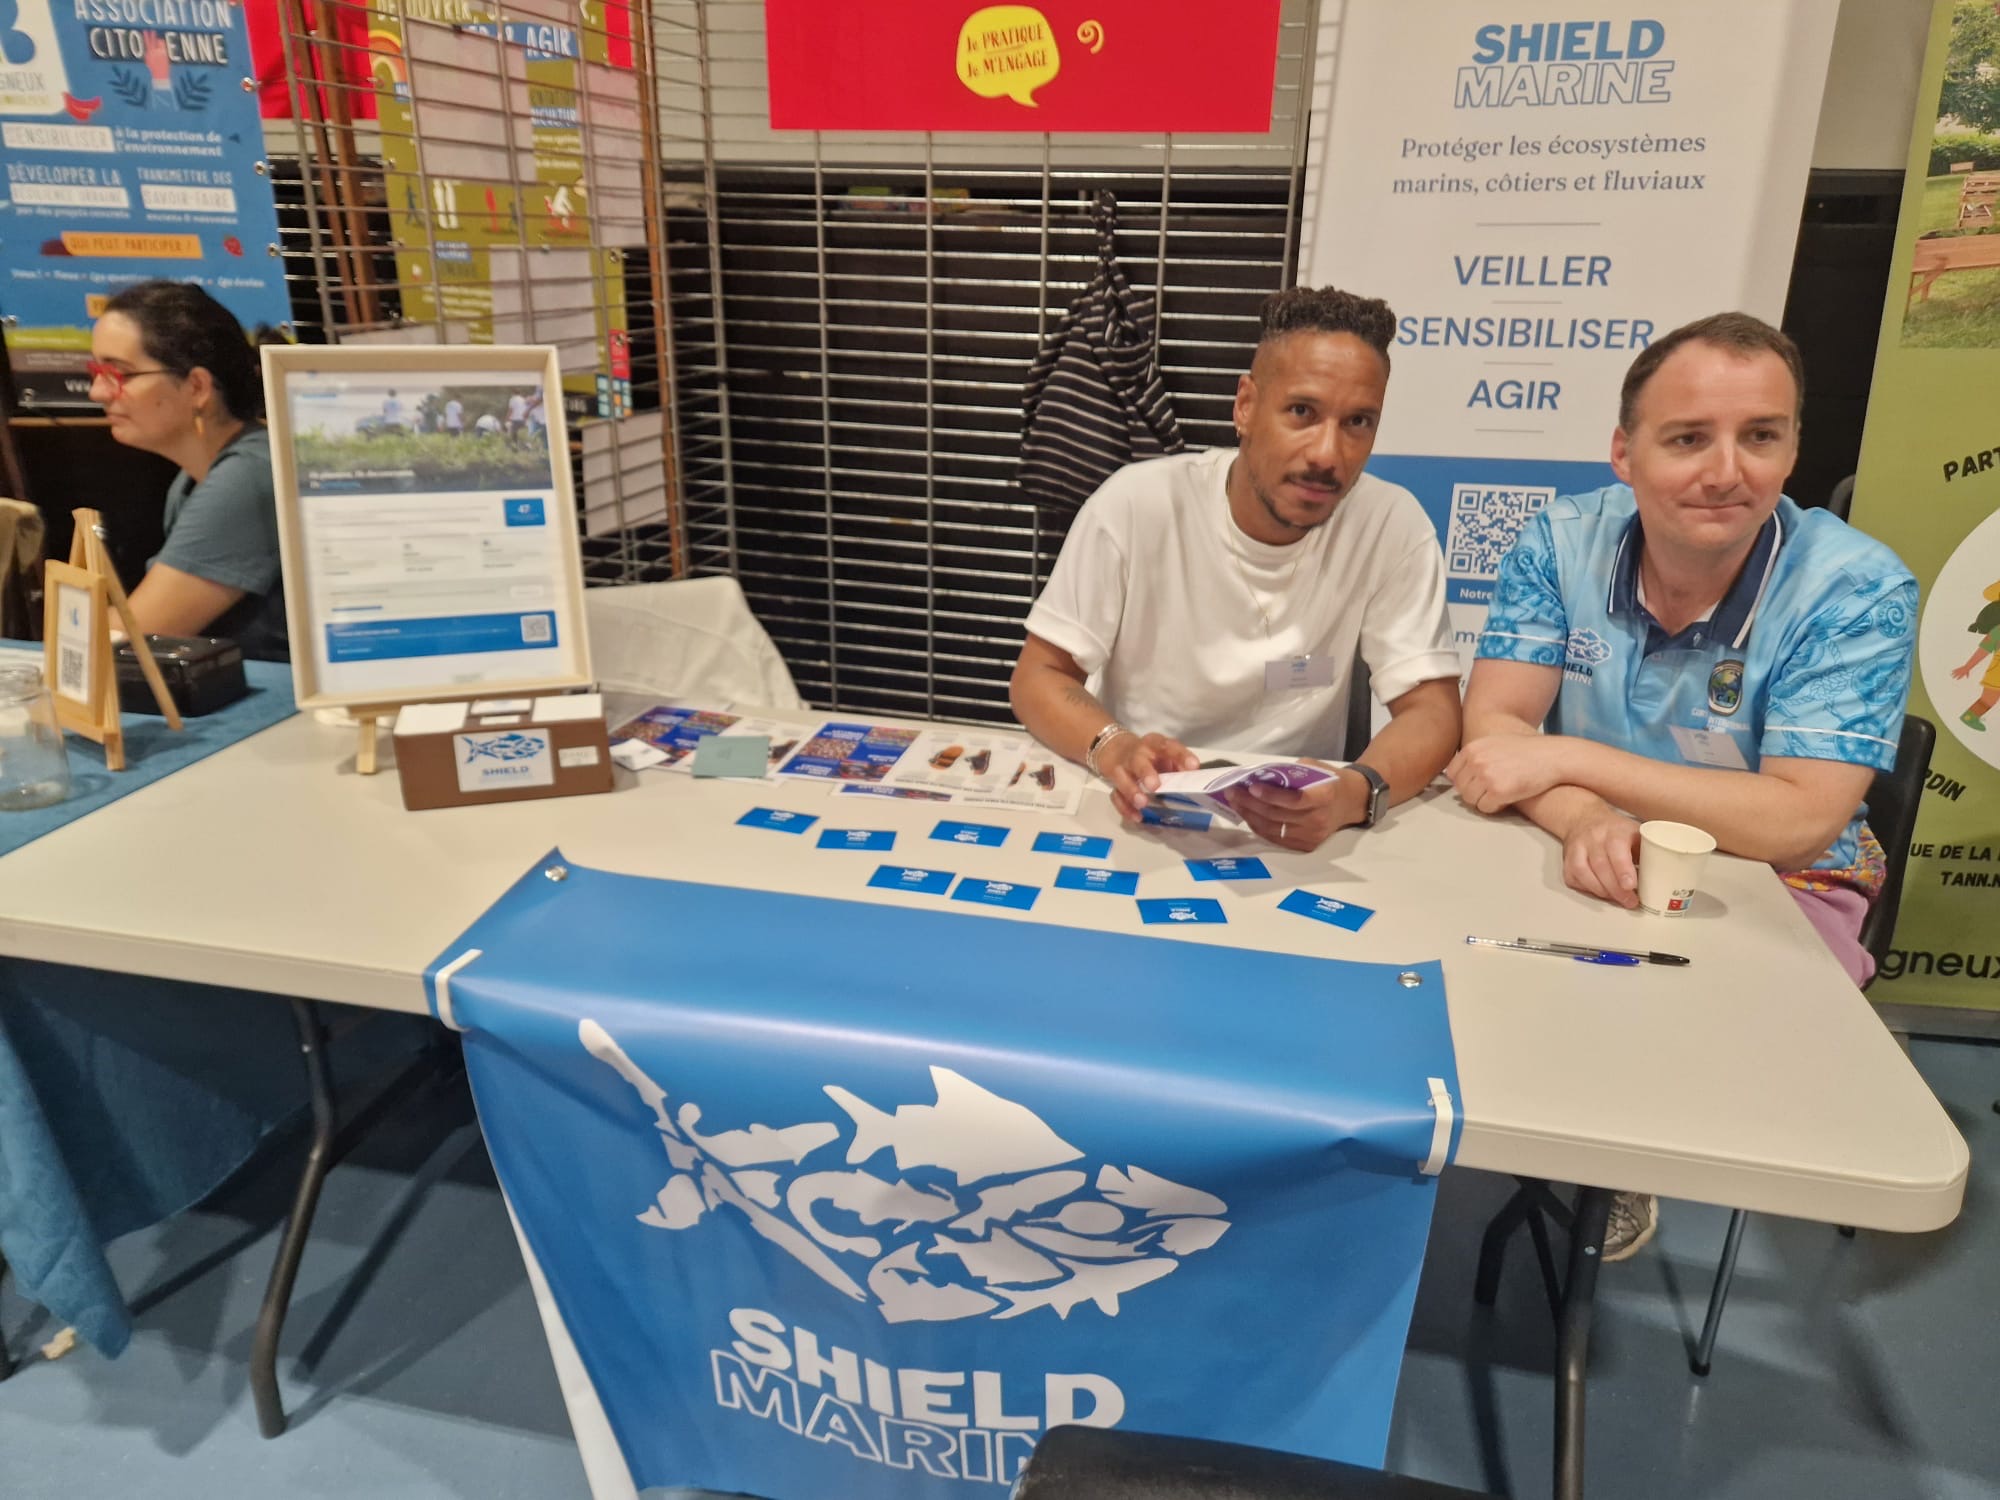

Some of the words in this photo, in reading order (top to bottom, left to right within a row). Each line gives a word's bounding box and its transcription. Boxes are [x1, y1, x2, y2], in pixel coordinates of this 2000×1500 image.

[75, 0, 234, 28] ASSOCIATION
[89, 27, 228, 64] CITOENNE
[526, 25, 573, 58] AGIR
[982, 23, 1043, 49] PRATIQUE
[1472, 19, 1665, 65] SHIELD
[1454, 60, 1675, 109] MARINE
[141, 129, 205, 142] protection
[1401, 136, 1504, 162] Protéger
[1509, 135, 1542, 156] les
[1548, 133, 1706, 160] écosystèmes
[101, 167, 121, 187] LA
[212, 170, 232, 185] DES
[1392, 173, 1480, 197] marins,
[1485, 171, 1567, 192] côtiers
[1573, 173, 1596, 192] et
[1603, 170, 1706, 191] fluviaux
[1454, 255, 1612, 287] VEILLER
[1397, 316, 1654, 350] SENSIBILISER
[1466, 379, 1561, 411] AGIR
[1459, 588, 1494, 600] Notre
[1564, 662, 1593, 677] IELD
[1939, 845, 1964, 859] DE
[1968, 846, 1992, 861] LA
[729, 1308, 1126, 1431] SHIELD
